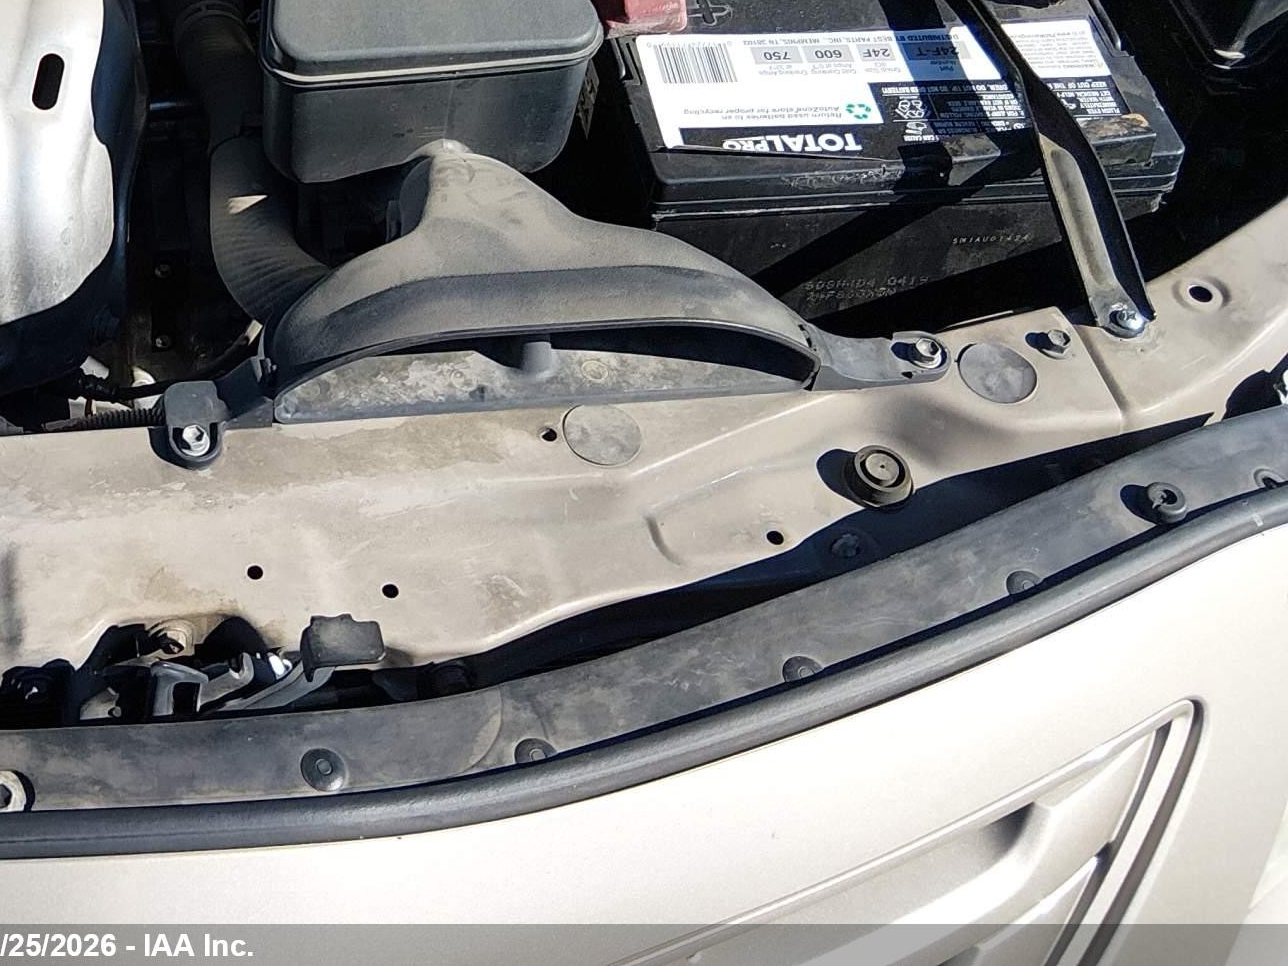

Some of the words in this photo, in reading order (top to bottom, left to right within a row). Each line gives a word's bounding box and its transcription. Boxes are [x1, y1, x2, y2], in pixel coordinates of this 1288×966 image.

[894, 34, 906, 42] BY
[763, 51, 792, 61] 750
[814, 49, 843, 60] 600
[862, 48, 890, 59] 24F
[916, 46, 960, 58] 24F-T
[684, 108, 724, 117] recycling
[726, 107, 755, 115] proper
[757, 107, 769, 115] for
[772, 107, 794, 115] store
[811, 112, 842, 120] Return
[721, 132, 863, 153] TOTALPRO
